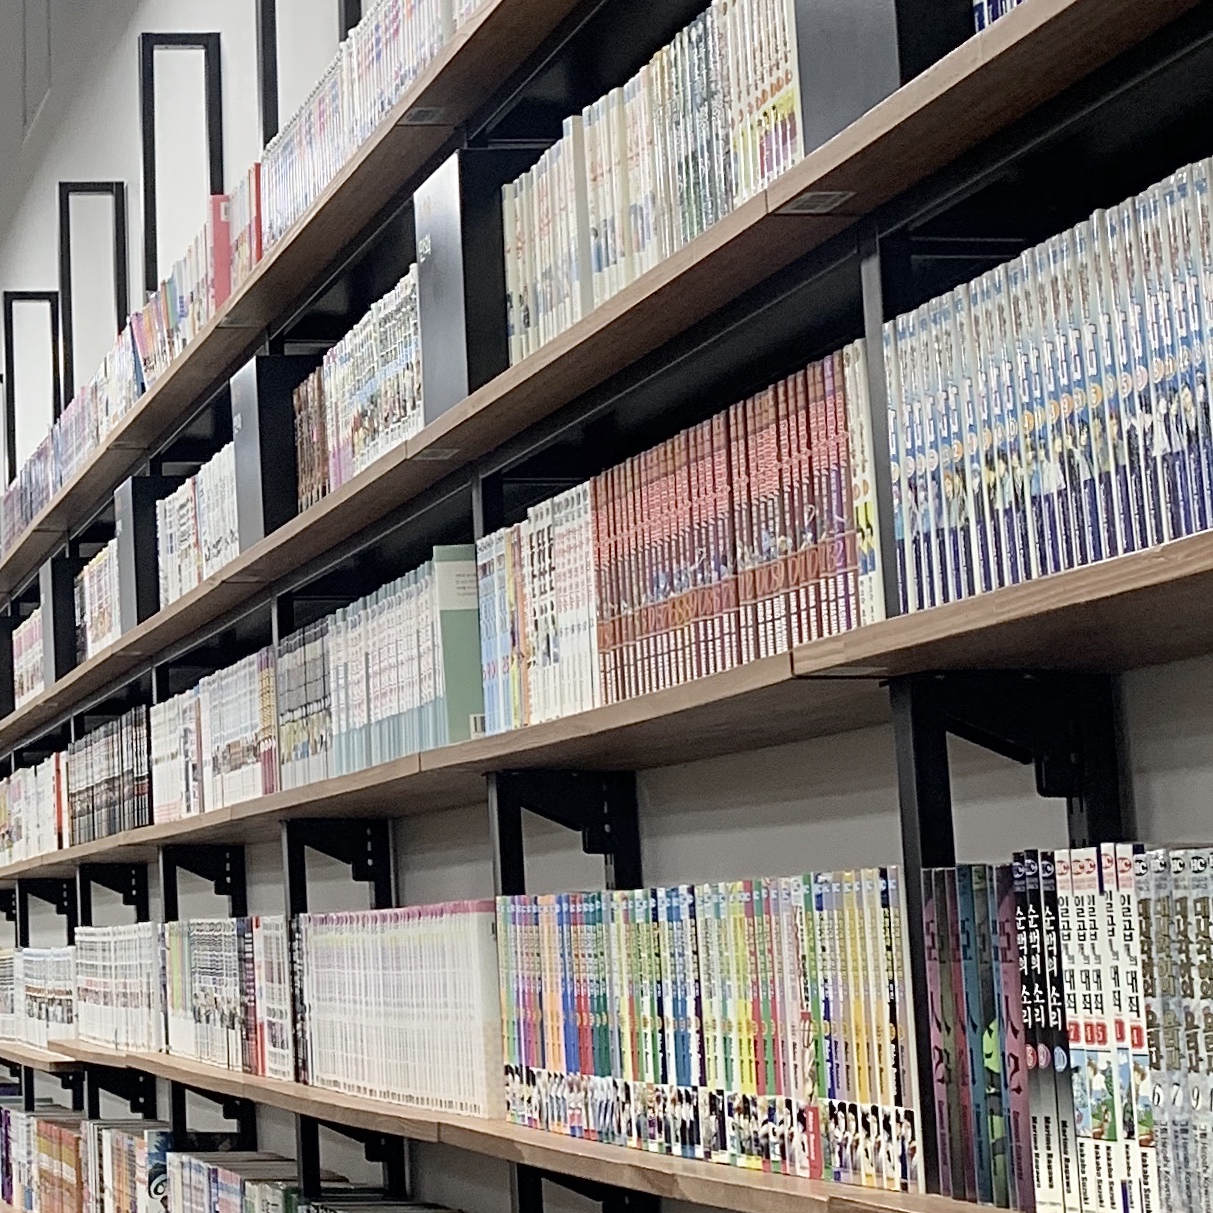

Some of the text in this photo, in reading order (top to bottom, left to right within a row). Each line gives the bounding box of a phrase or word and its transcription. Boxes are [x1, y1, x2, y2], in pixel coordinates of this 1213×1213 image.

[1120, 894, 1135, 942] 일곱
[1032, 983, 1045, 1028] 소리
[1126, 971, 1141, 1018] 대죄
[1141, 1152, 1150, 1186] Nakaba
